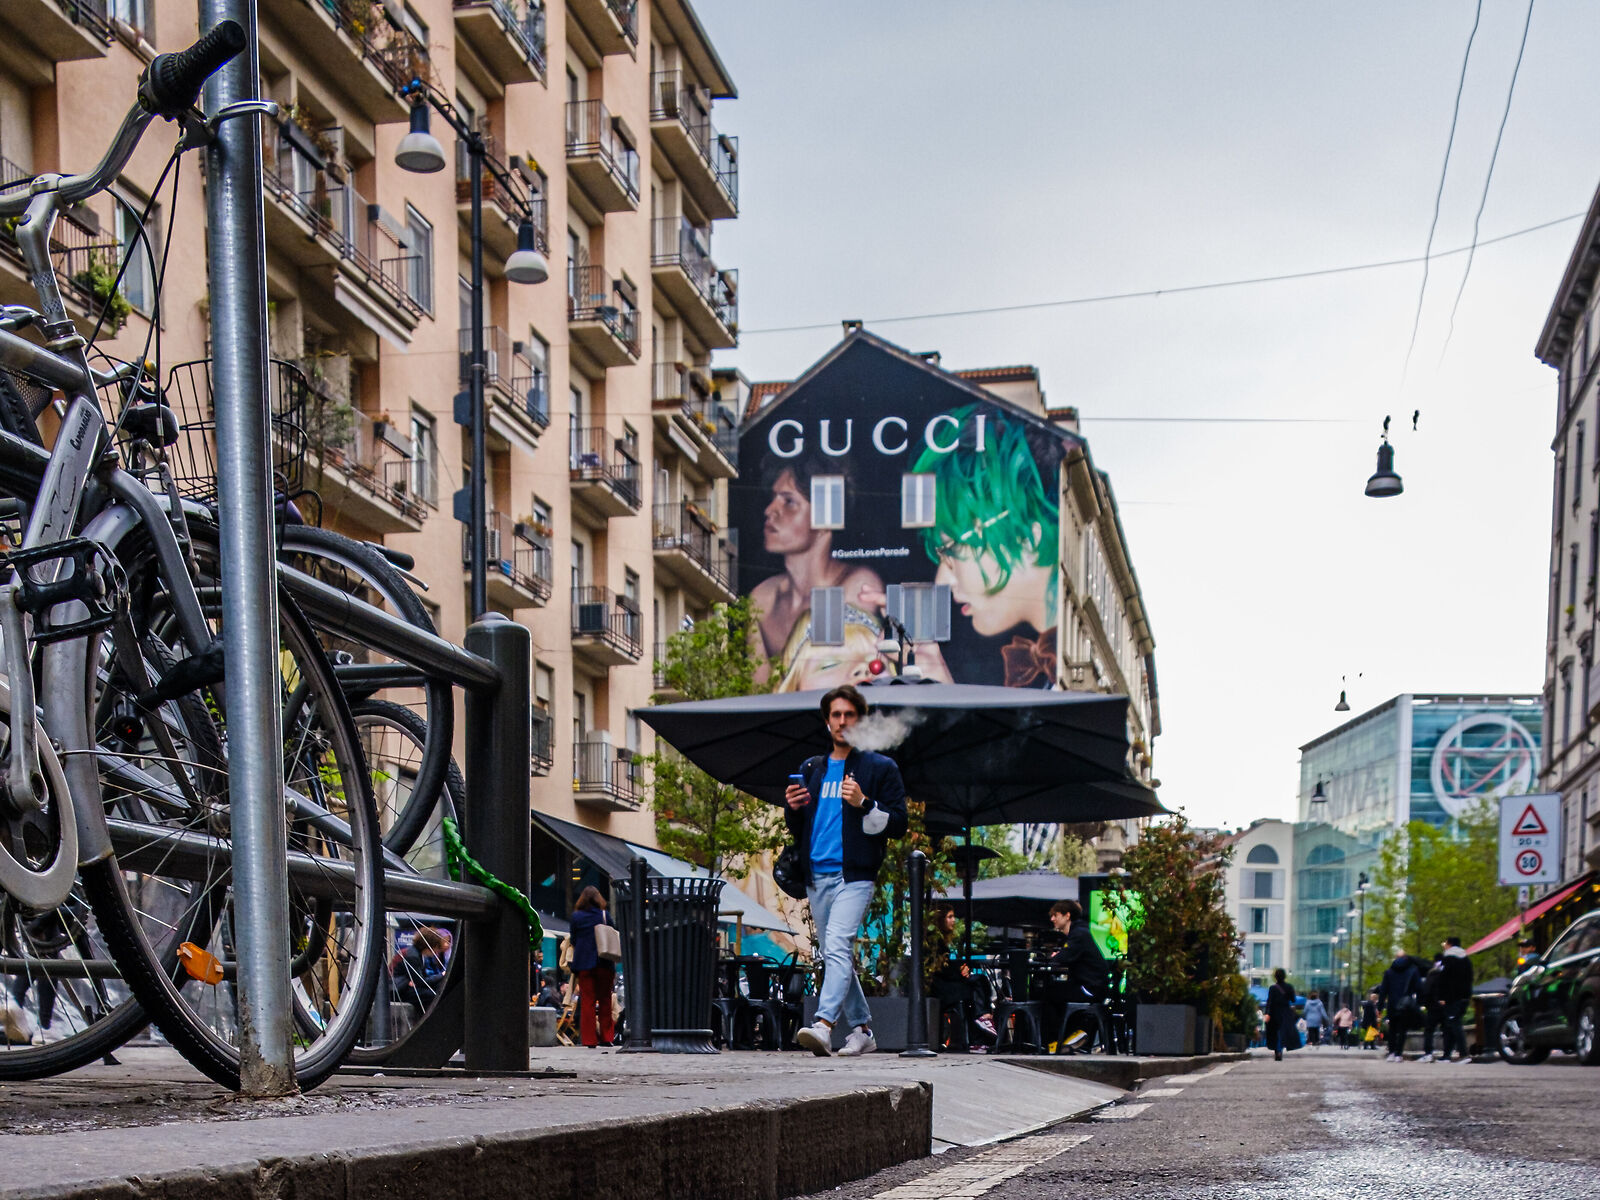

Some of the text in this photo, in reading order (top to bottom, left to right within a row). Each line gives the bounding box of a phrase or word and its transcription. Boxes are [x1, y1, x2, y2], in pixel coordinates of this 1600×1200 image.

[768, 414, 986, 458] GUCCI
[832, 547, 910, 558] #GucciLoveParade
[1522, 856, 1537, 868] 30
